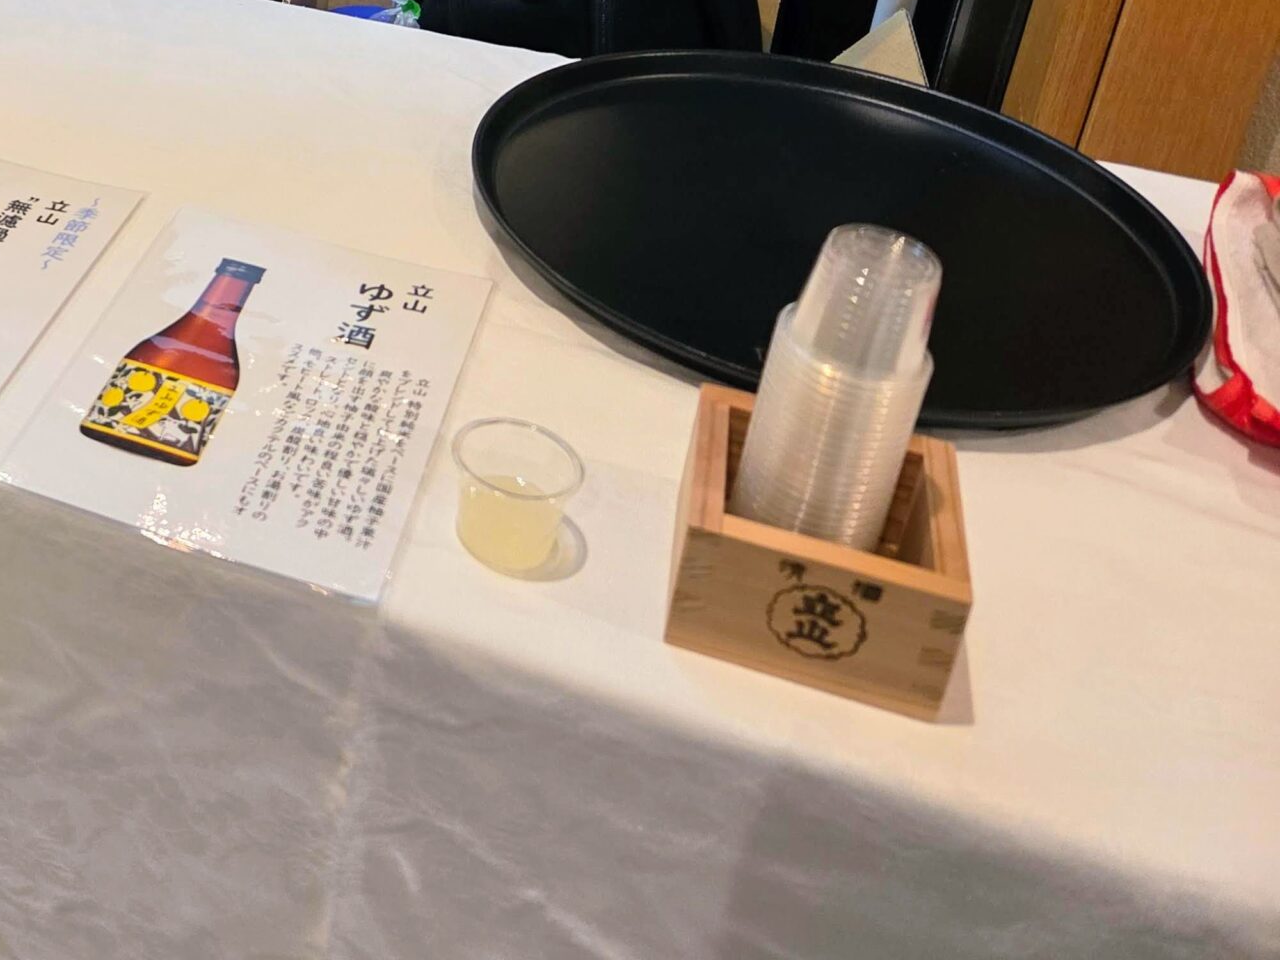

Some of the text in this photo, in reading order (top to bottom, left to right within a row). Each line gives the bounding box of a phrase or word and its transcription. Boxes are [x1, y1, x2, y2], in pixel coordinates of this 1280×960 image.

[36, 200, 71, 226] 立山
[337, 282, 394, 350] ゆず酒
[402, 283, 435, 315] 立山
[786, 592, 843, 650] 立山
